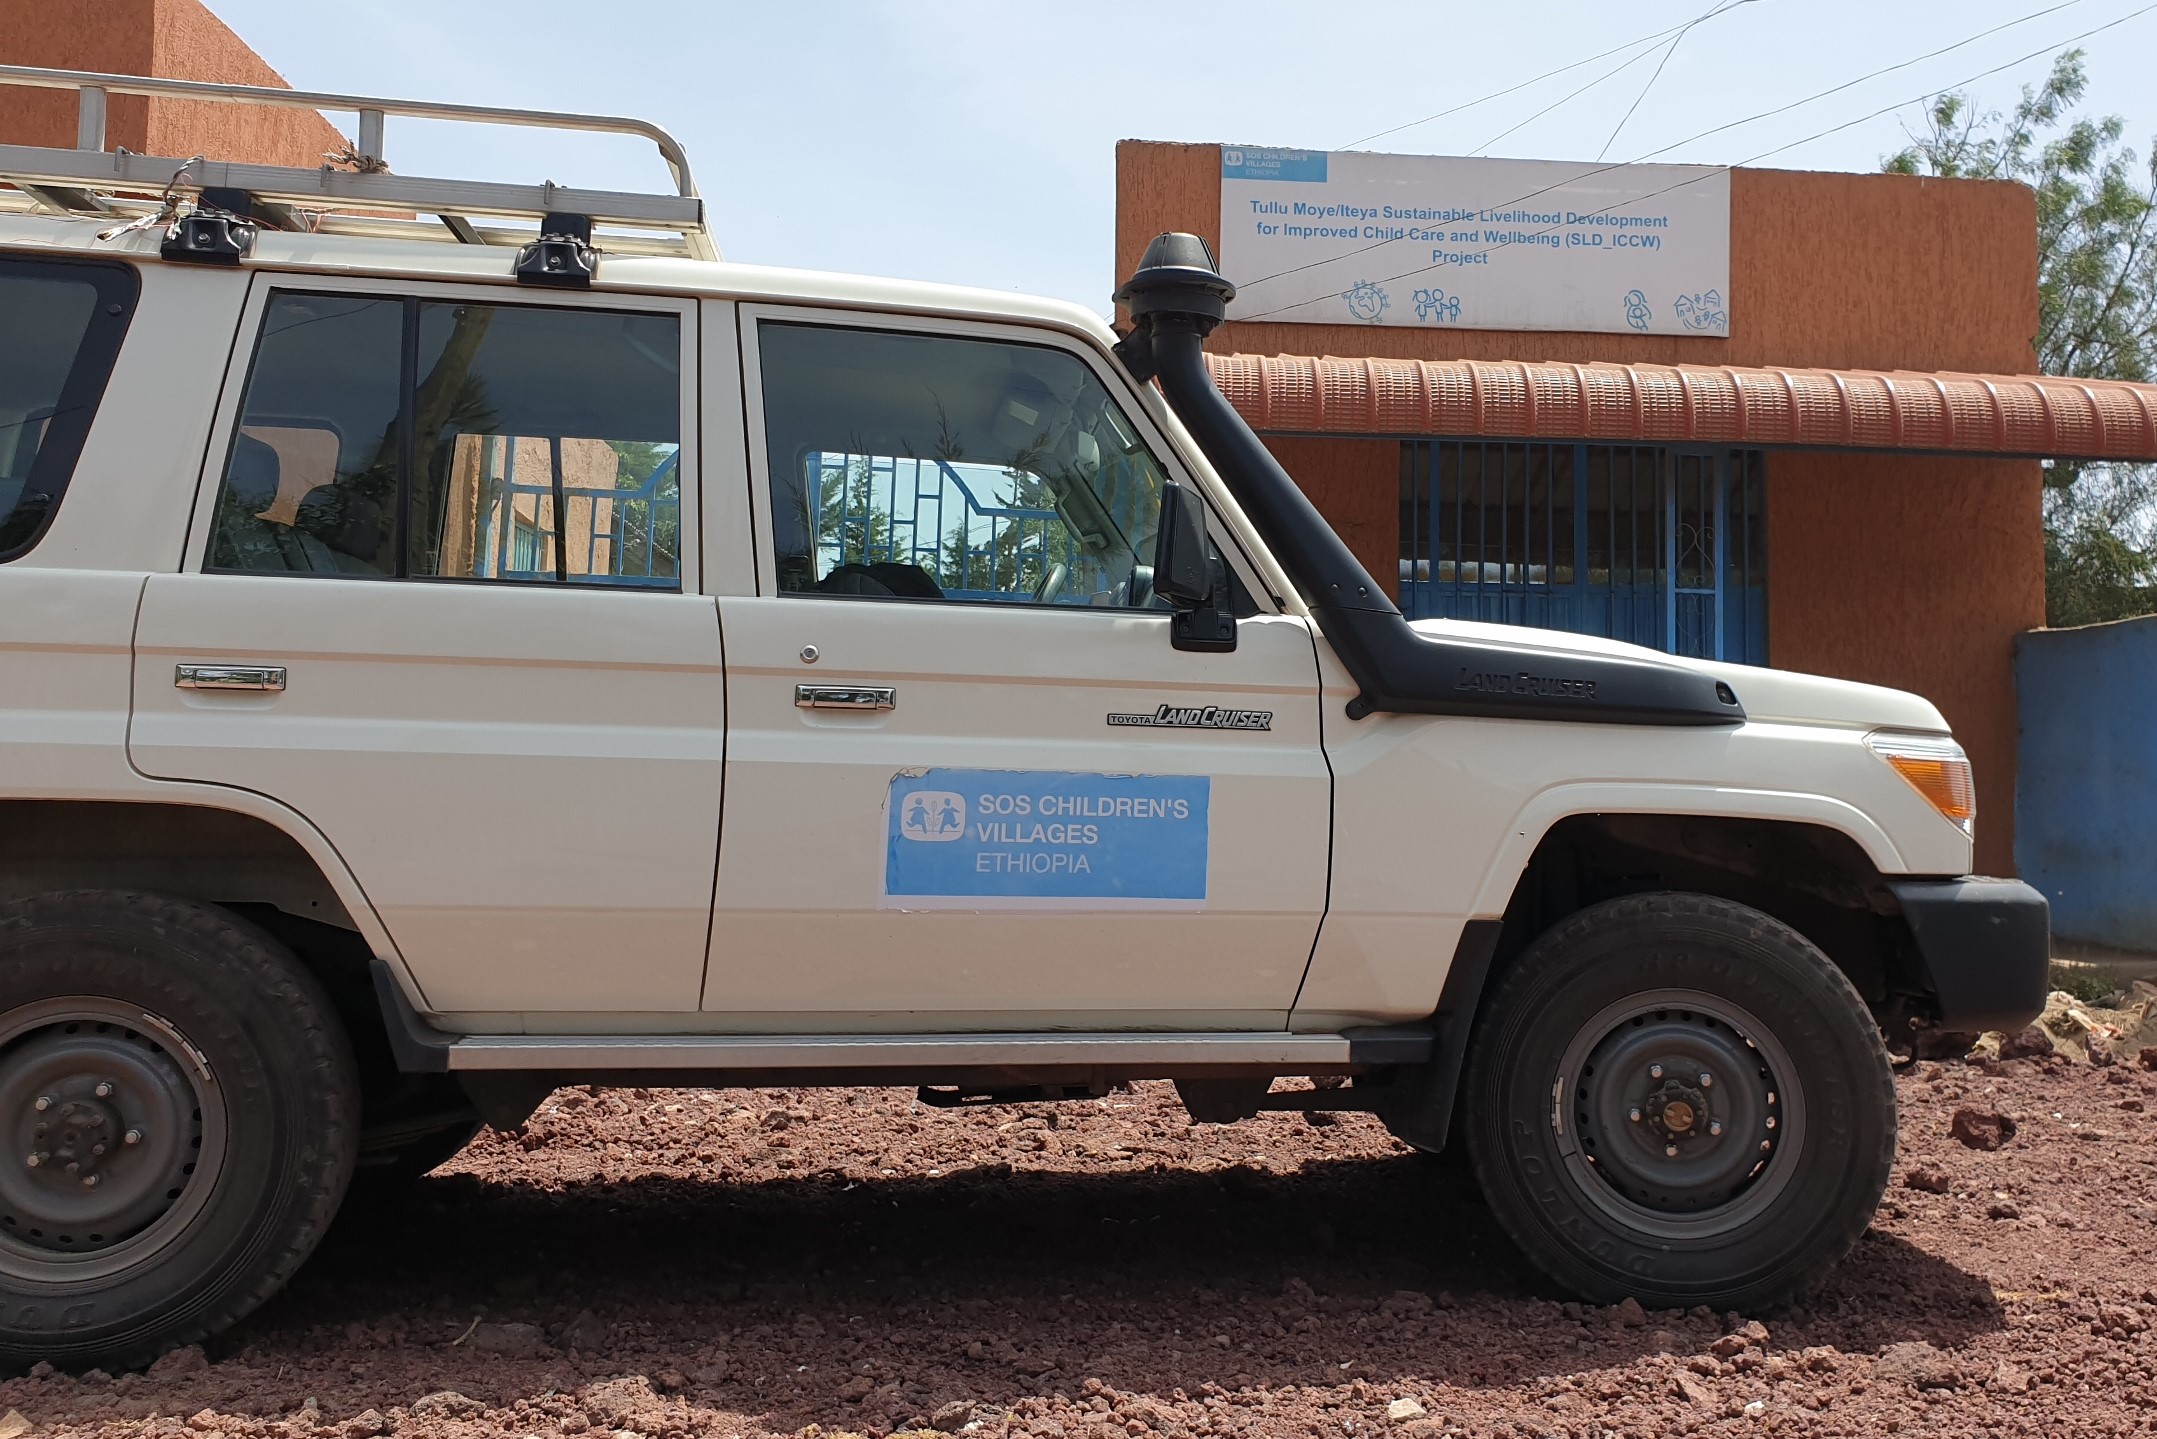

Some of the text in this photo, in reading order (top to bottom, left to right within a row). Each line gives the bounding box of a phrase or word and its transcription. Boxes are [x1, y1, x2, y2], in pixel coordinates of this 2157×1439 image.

[1246, 168, 1280, 176] ETHIOPIA
[1250, 200, 1668, 229] Tullu Moye/Iteya Sustainable Livelihood Development
[1257, 222, 1661, 251] for Improved Child Care and Wellbeing (SLD_ICCW)
[1432, 249, 1488, 267] Project
[1111, 715, 1151, 724] TOYOTA
[977, 794, 1189, 819] SOS CHILDREN'S
[977, 823, 1098, 846] VILLAGES
[975, 852, 1091, 874] ETHIOPIA
